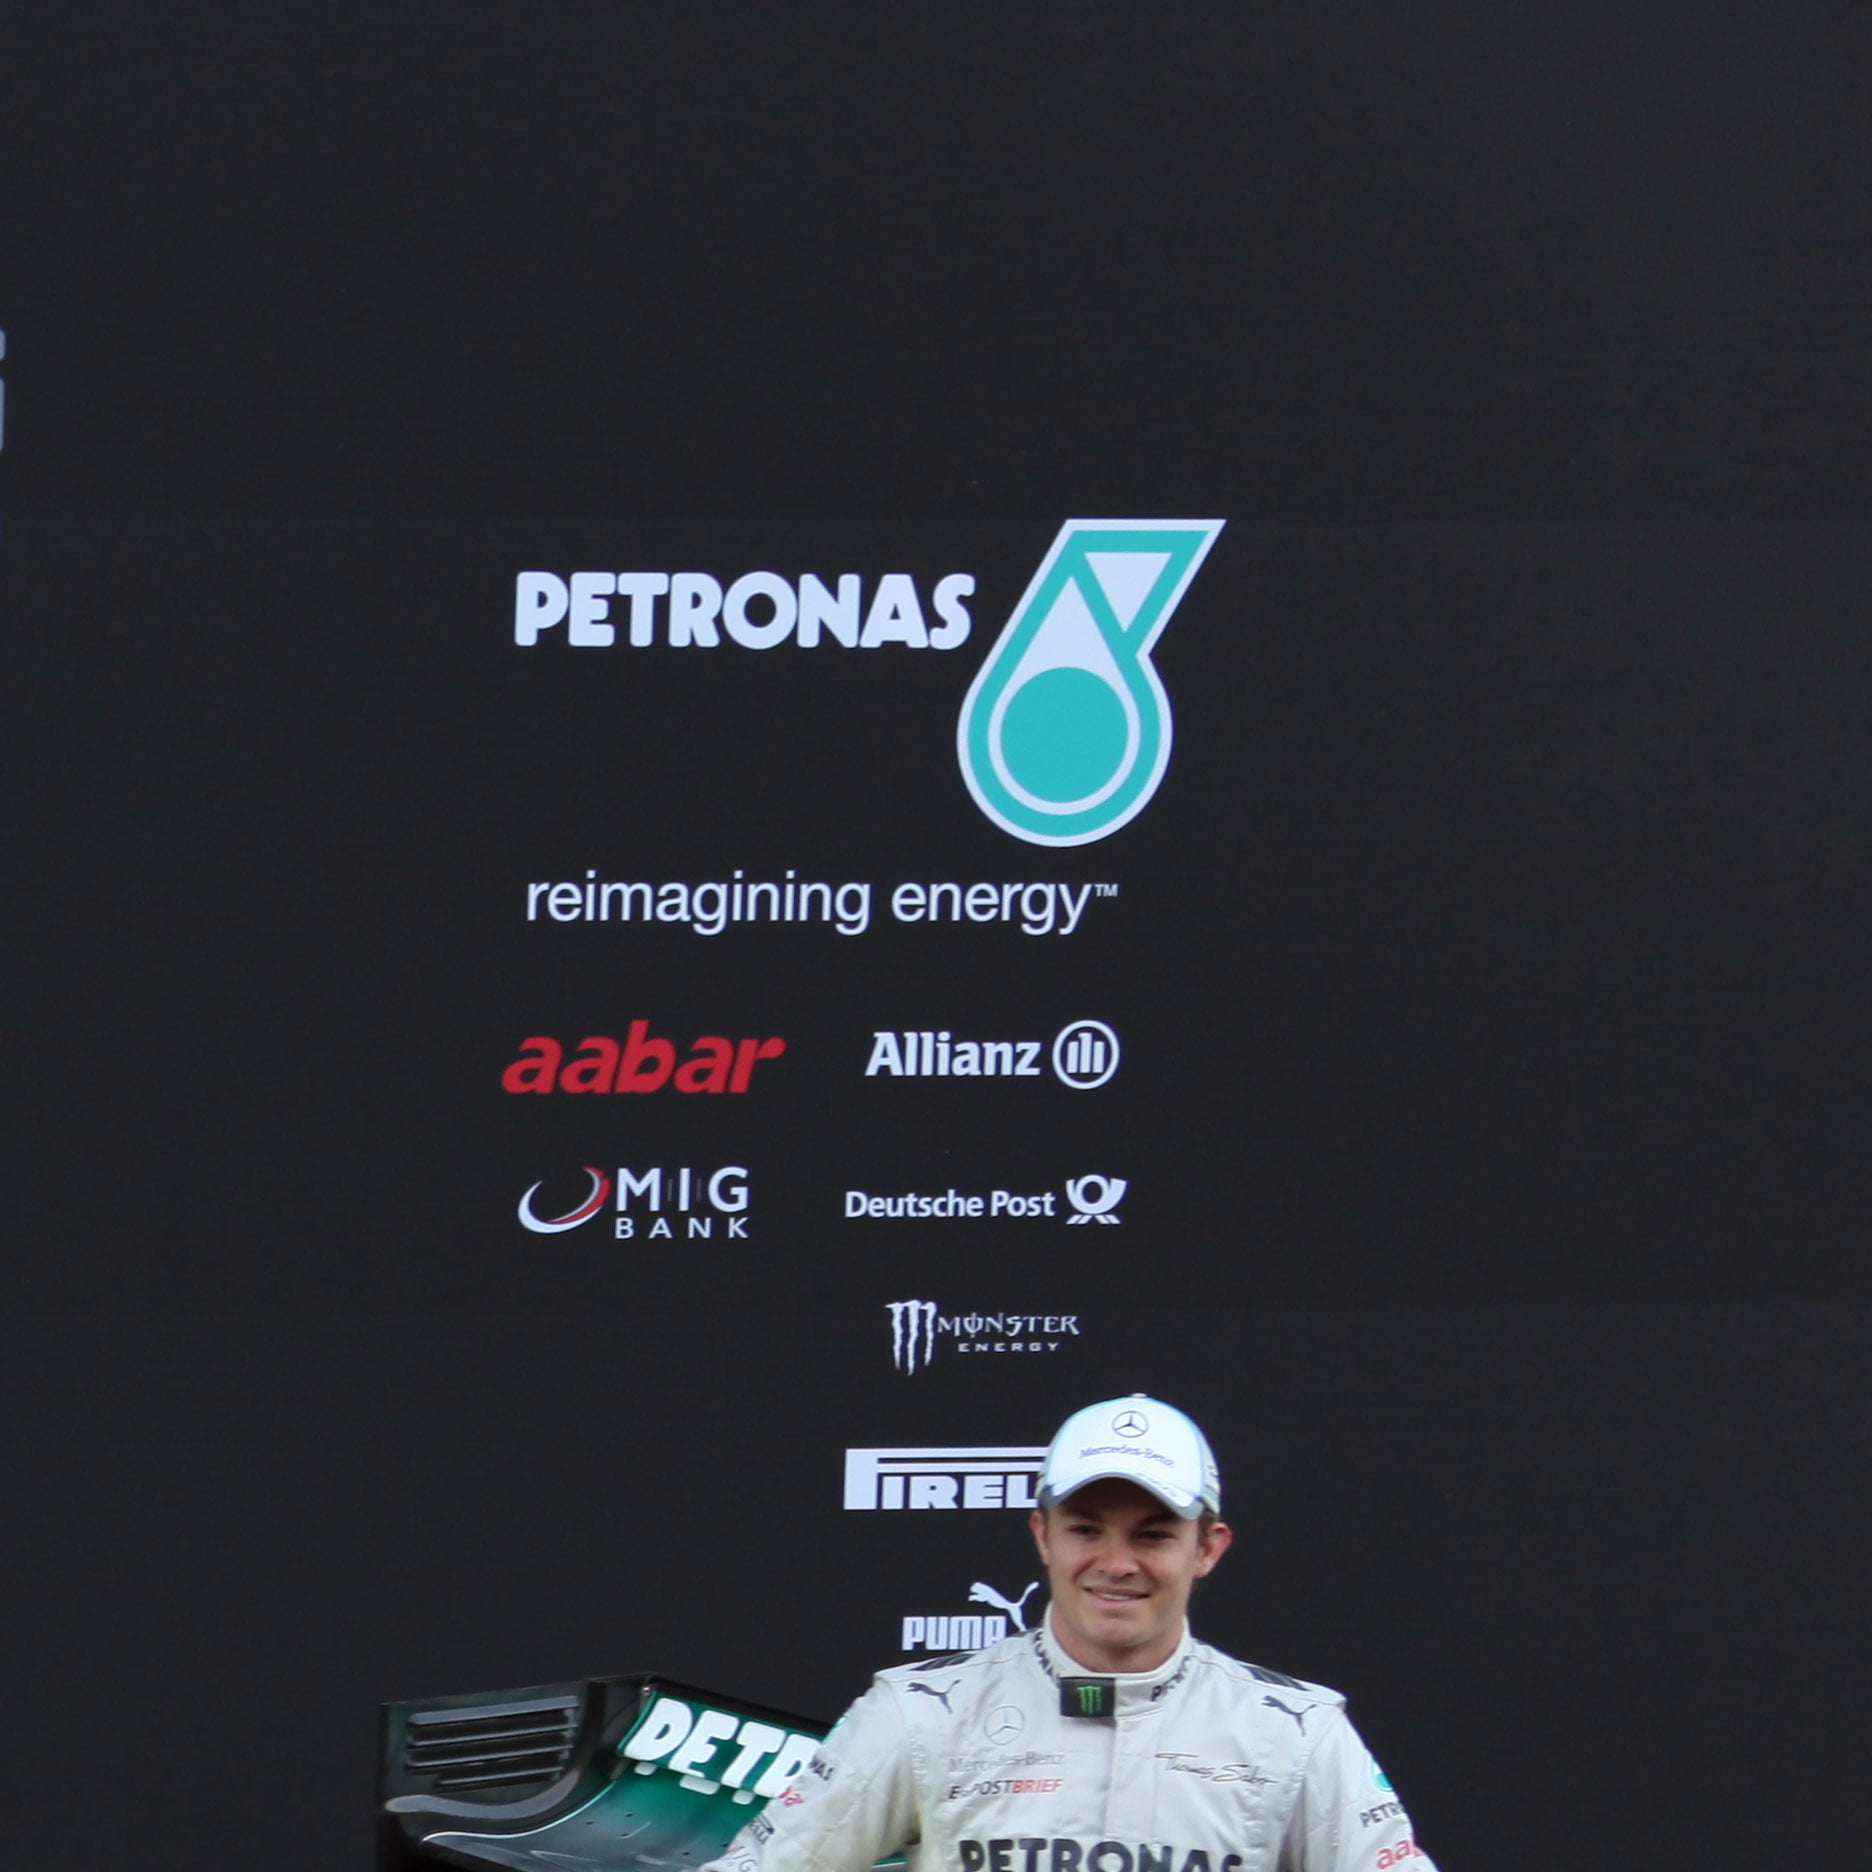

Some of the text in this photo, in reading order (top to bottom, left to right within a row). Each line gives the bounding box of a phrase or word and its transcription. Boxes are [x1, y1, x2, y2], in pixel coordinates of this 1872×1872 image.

[514, 570, 977, 650] PETRONAS
[527, 869, 871, 936] reimagining
[502, 1020, 786, 1094] aabar
[865, 1031, 1043, 1076] Allianz
[616, 1166, 750, 1212] MIG
[845, 1189, 1056, 1217] Deutsche Post
[615, 1217, 749, 1240] BANK
[937, 1312, 1080, 1336] MONSTER
[958, 1342, 1059, 1352] ENERGY
[844, 1447, 1053, 1510] PIREL
[902, 1615, 1007, 1651] PUMA
[624, 1697, 822, 1805] PETR
[1360, 1801, 1405, 1828] PETR
